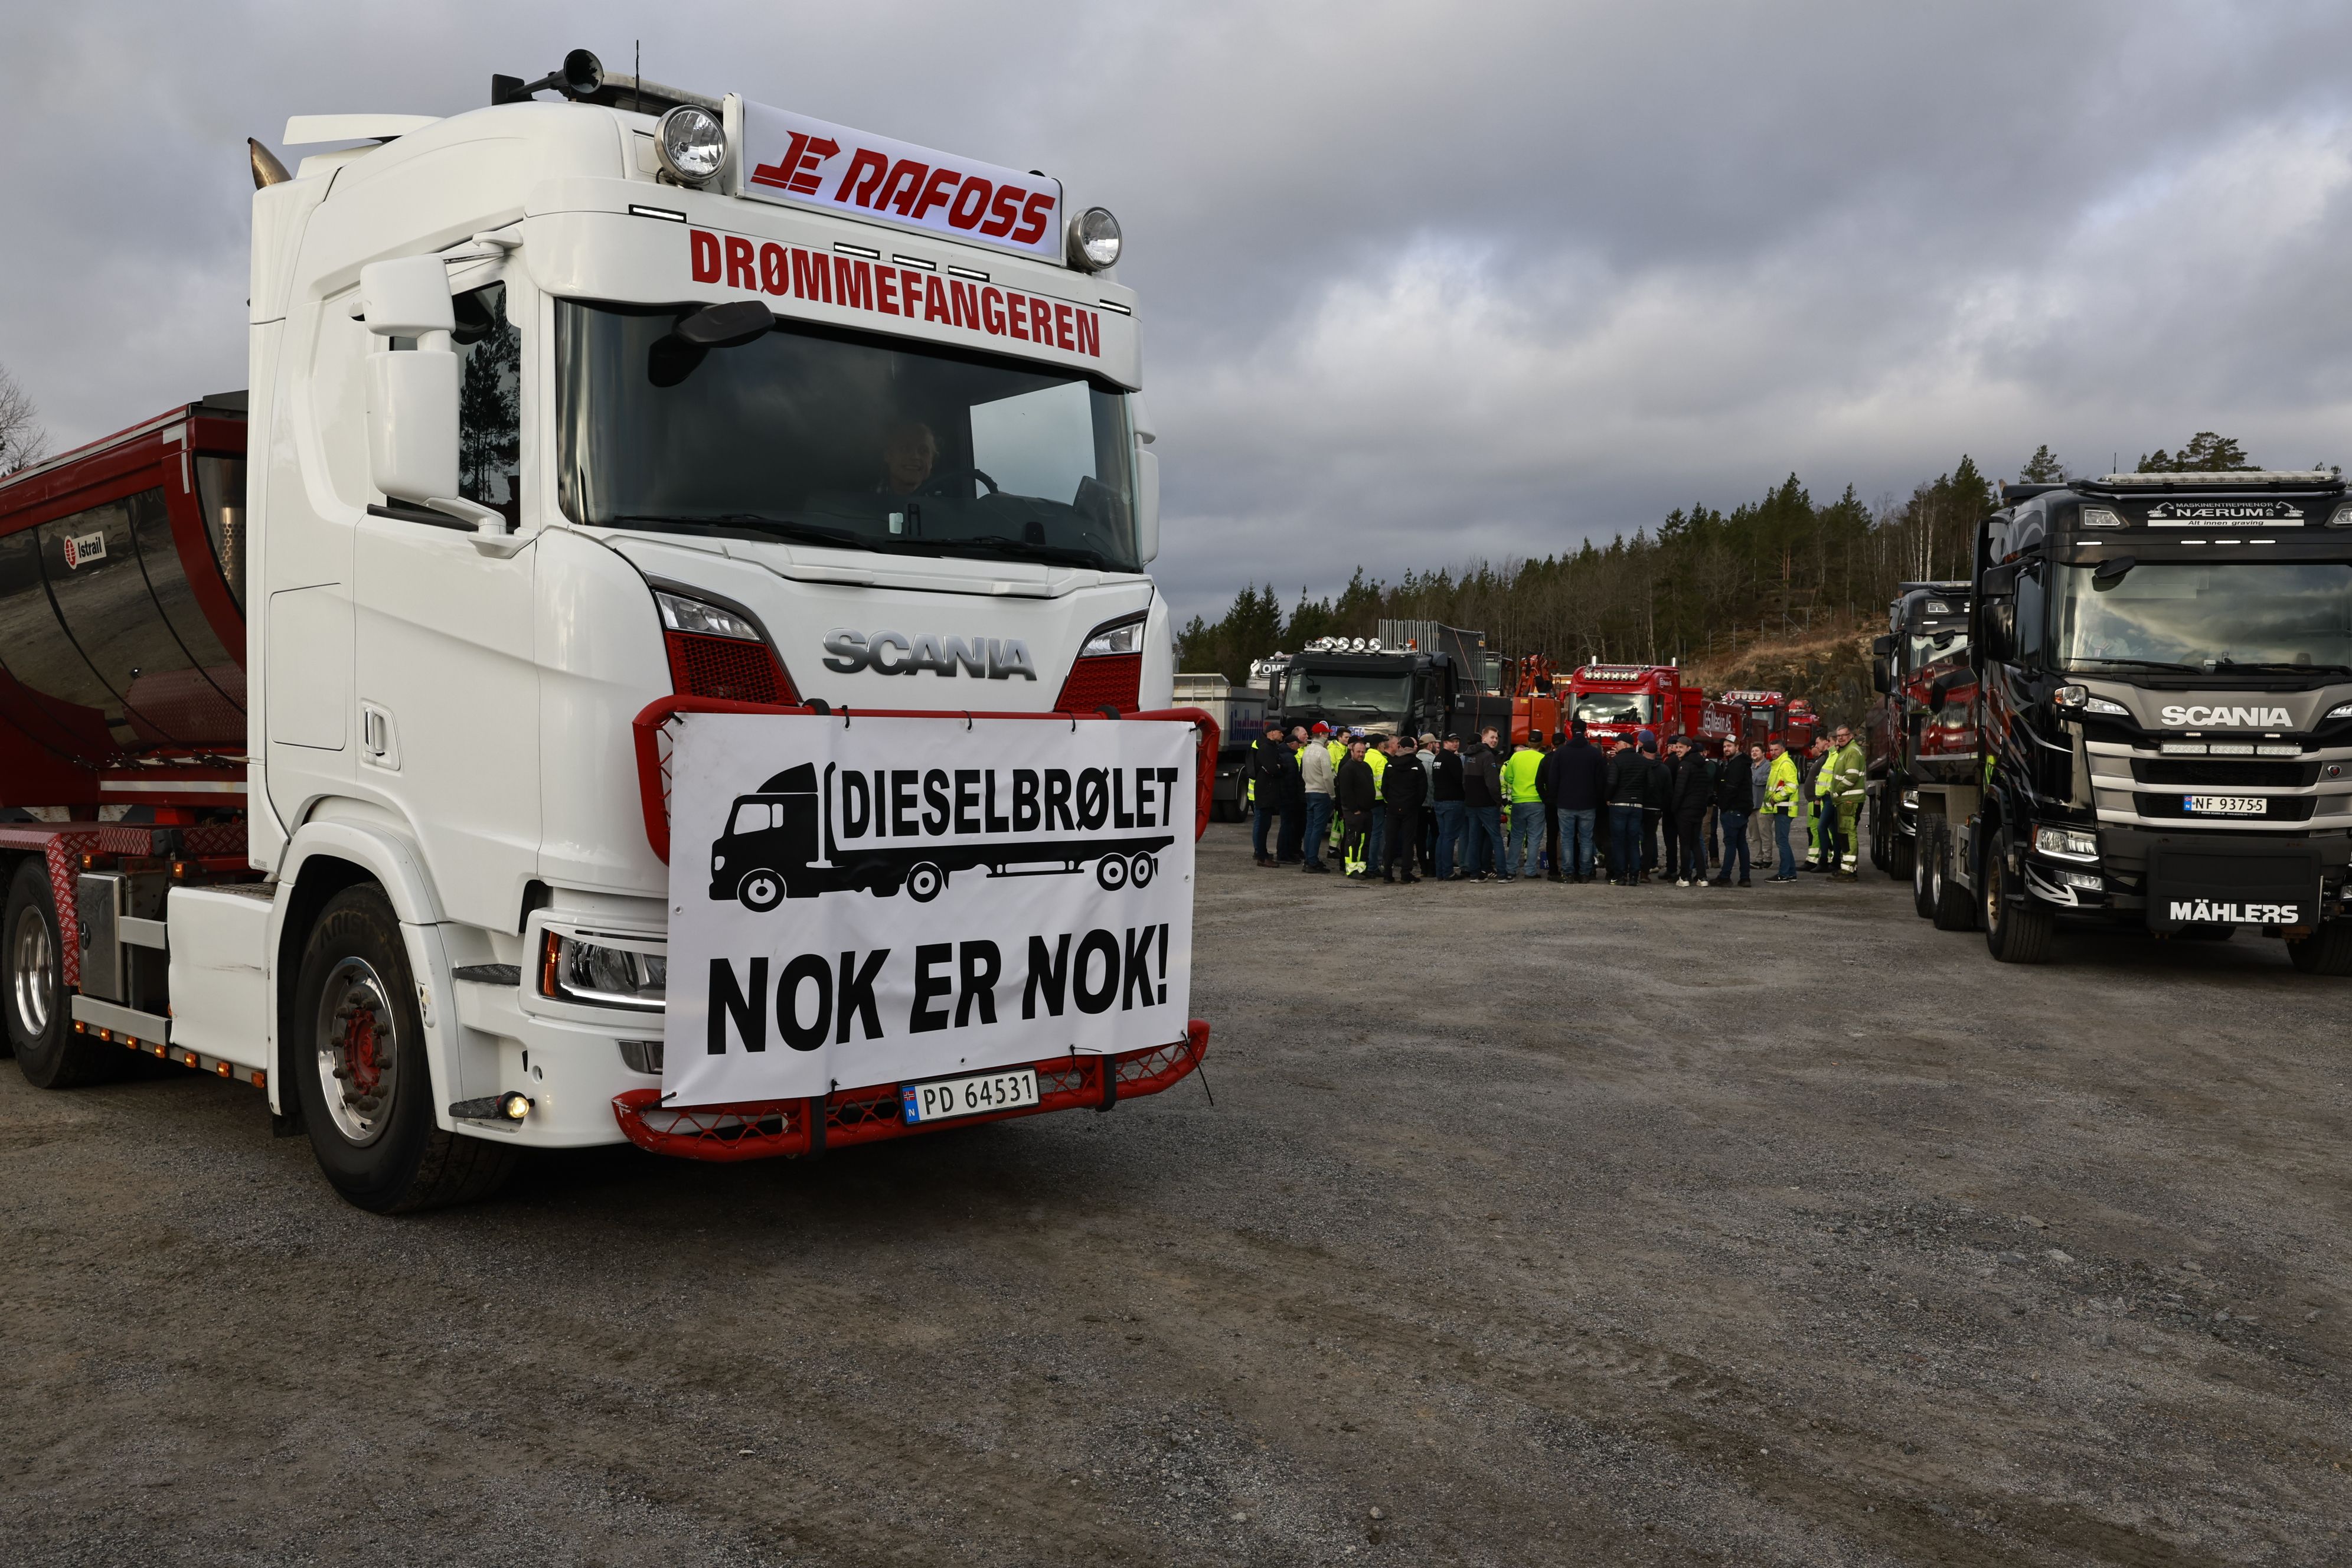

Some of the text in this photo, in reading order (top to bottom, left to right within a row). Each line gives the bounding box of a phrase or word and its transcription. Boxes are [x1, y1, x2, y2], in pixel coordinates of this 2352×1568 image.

[834, 147, 1056, 245] RAFOSS
[689, 228, 1100, 358] DRØMMEFANGEREN
[2176, 508, 2263, 517] NÆRUM
[77, 536, 103, 559] Istrail
[821, 627, 1038, 681] SCANIA
[2160, 705, 2294, 727] SCANIA
[842, 766, 1178, 839] DIESELBRØLET
[2196, 798, 2263, 811] NF 93755
[2170, 899, 2298, 923] MÄHLERS
[707, 923, 1170, 1056] NOK ER NOK!
[923, 1074, 1033, 1115] PD 64531
